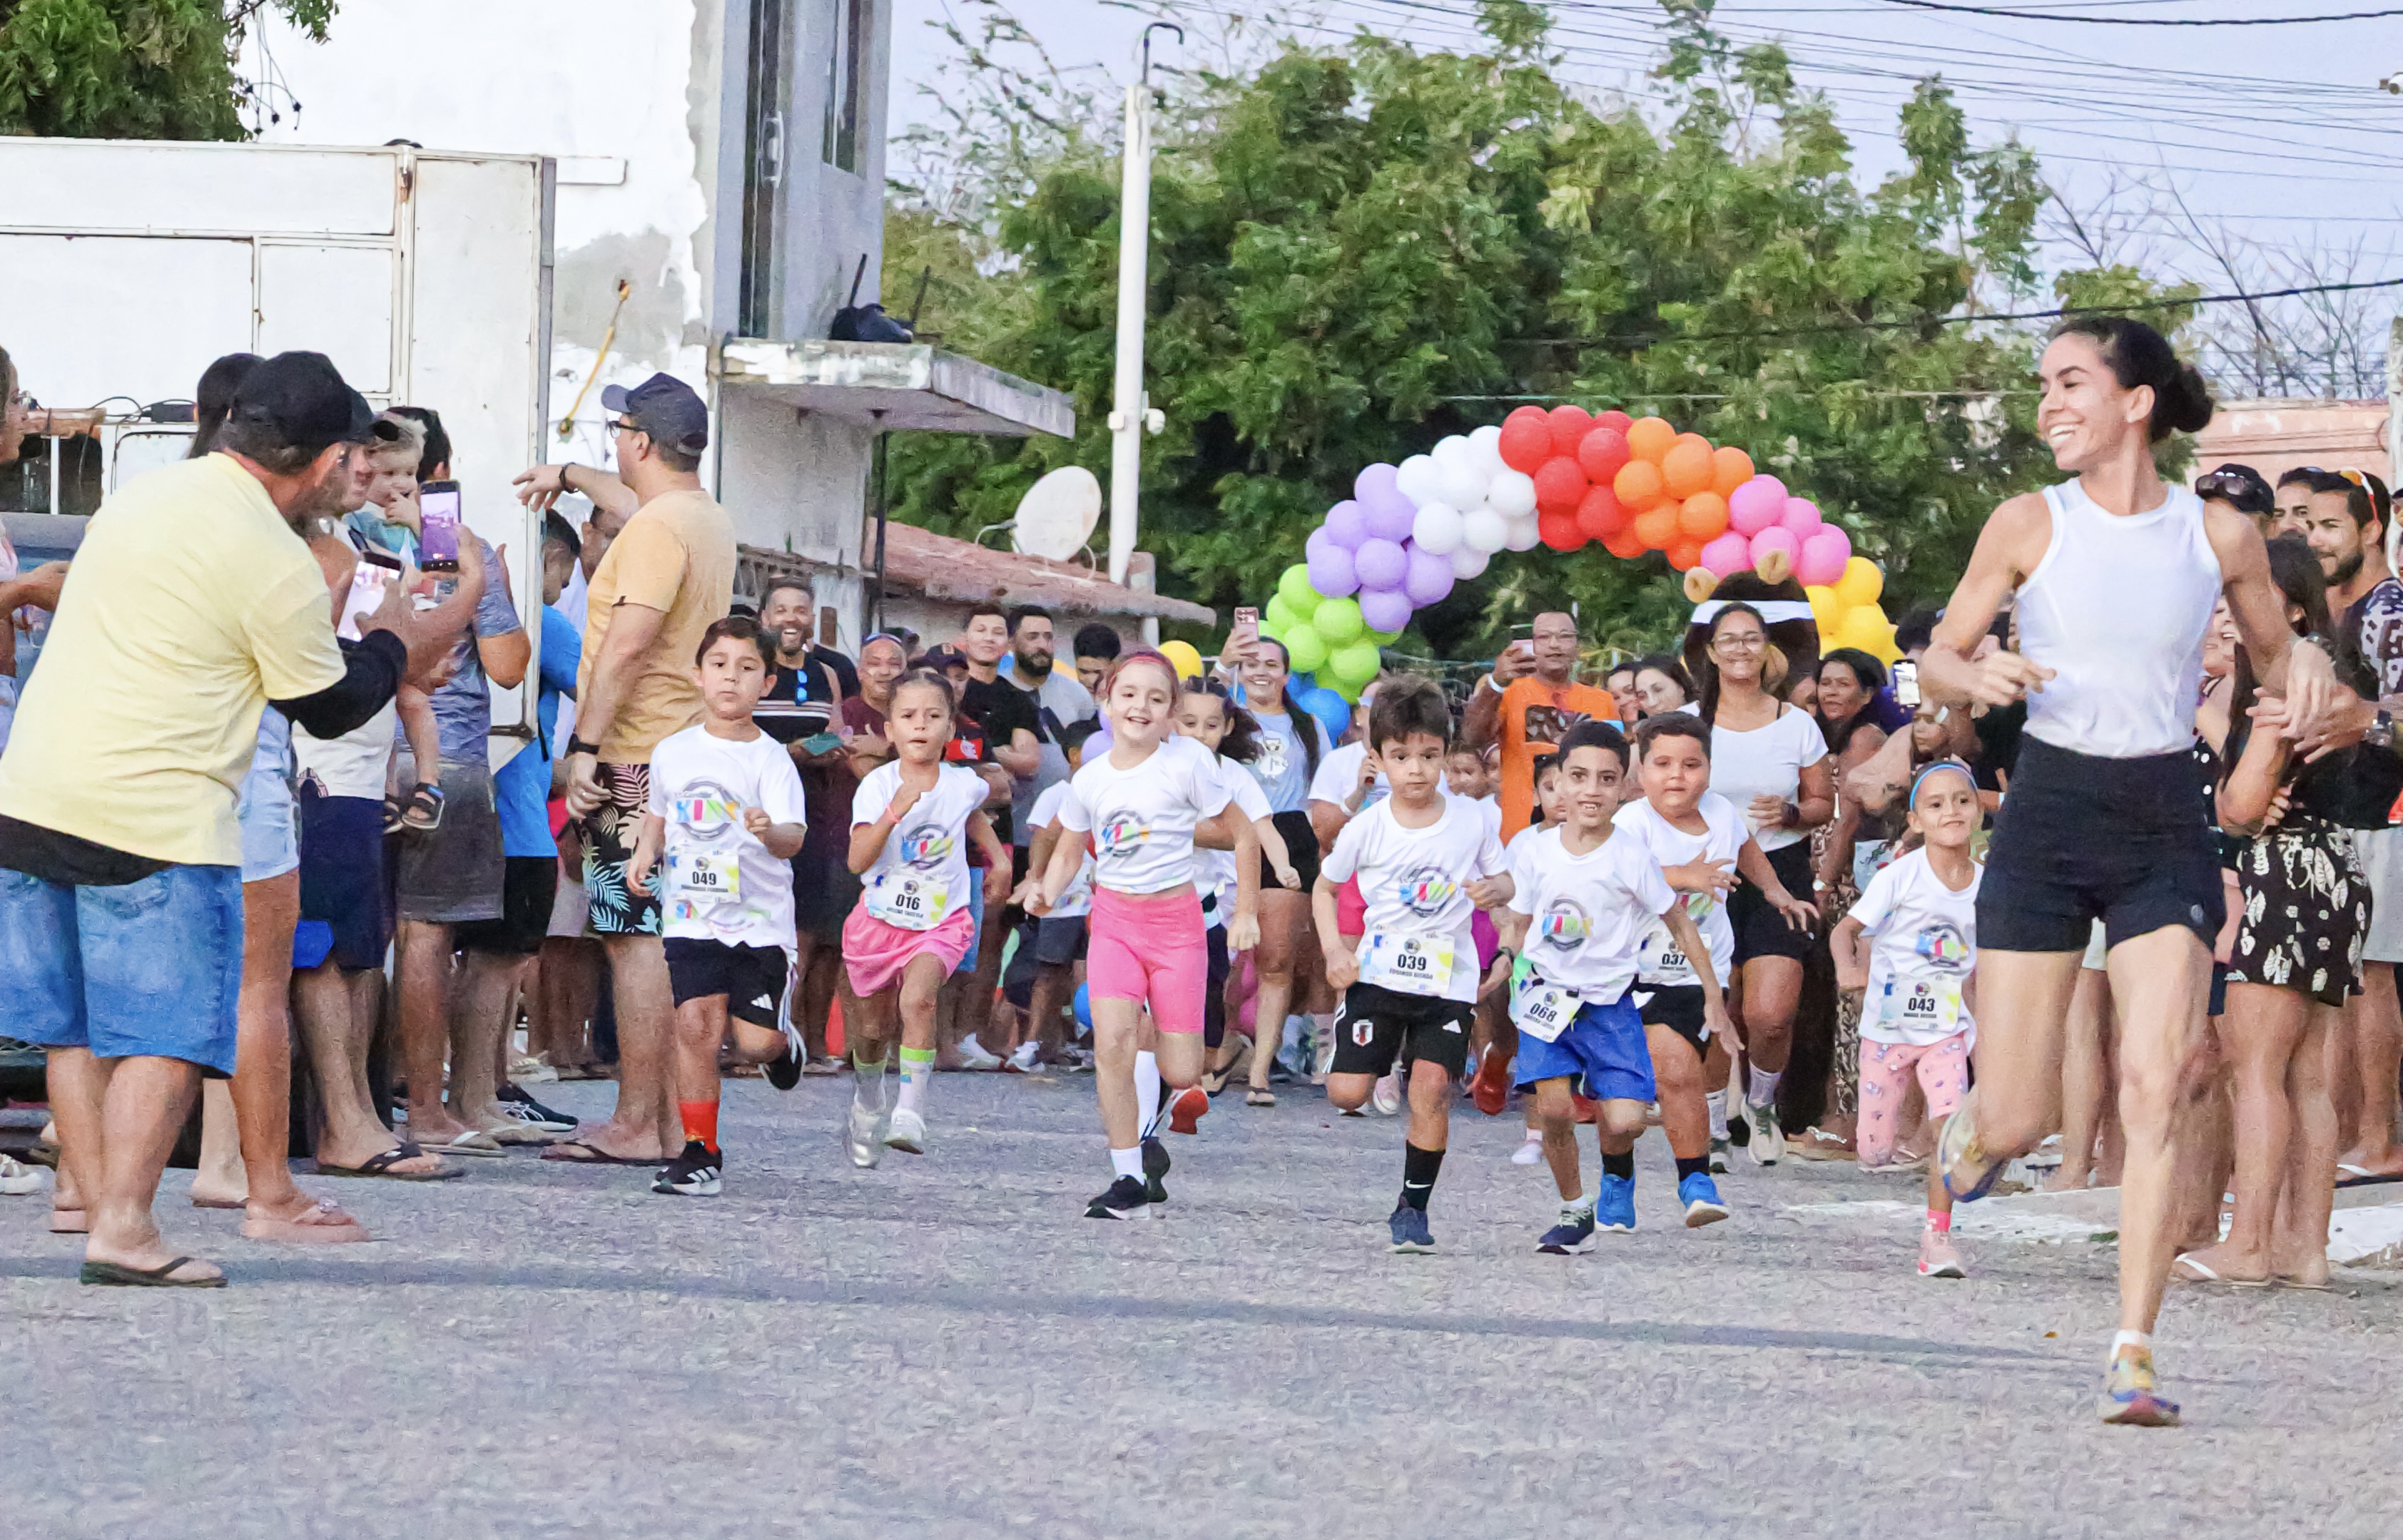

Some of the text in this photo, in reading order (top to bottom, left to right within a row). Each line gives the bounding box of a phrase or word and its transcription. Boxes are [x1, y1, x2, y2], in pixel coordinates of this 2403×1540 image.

[691, 871, 717, 886] 049
[895, 894, 921, 911] 016
[1397, 954, 1427, 972] 039
[1662, 953, 1687, 966] 037
[1530, 1002, 1558, 1023] 068
[1908, 997, 1936, 1012] 043
